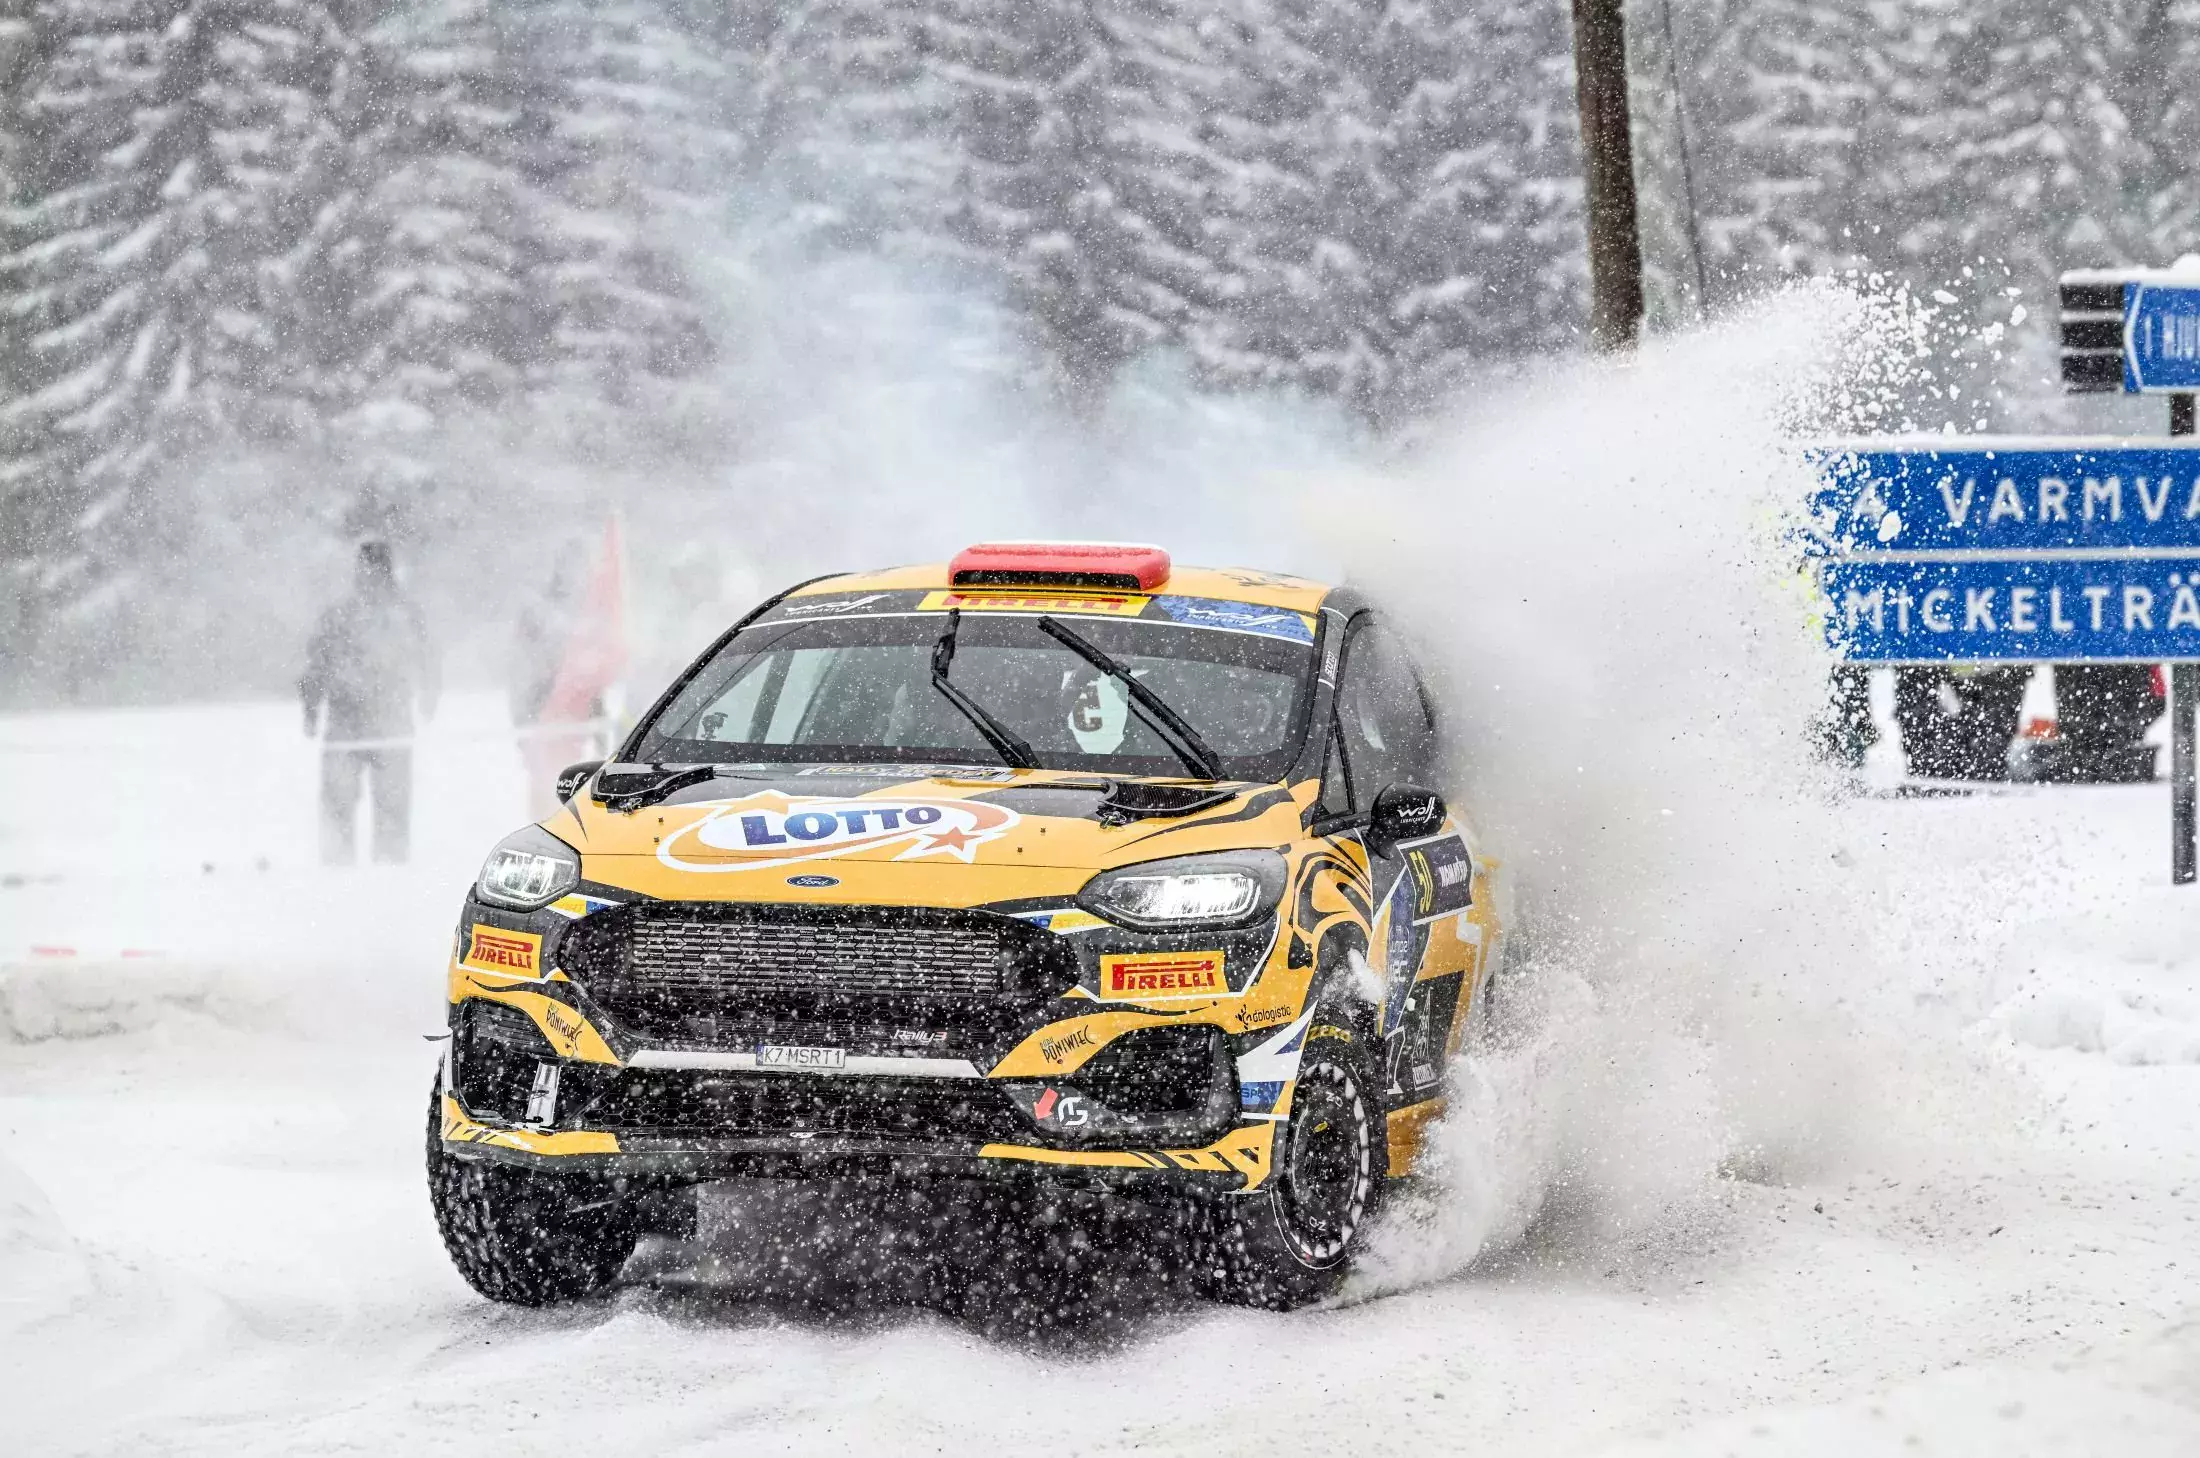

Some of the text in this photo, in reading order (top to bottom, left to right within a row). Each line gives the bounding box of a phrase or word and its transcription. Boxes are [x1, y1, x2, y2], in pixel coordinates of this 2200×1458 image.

[741, 806, 942, 846] LOTTO
[1397, 796, 1436, 824] wolf
[472, 933, 534, 969] PIRELLI
[1111, 960, 1216, 990] PIRELLI
